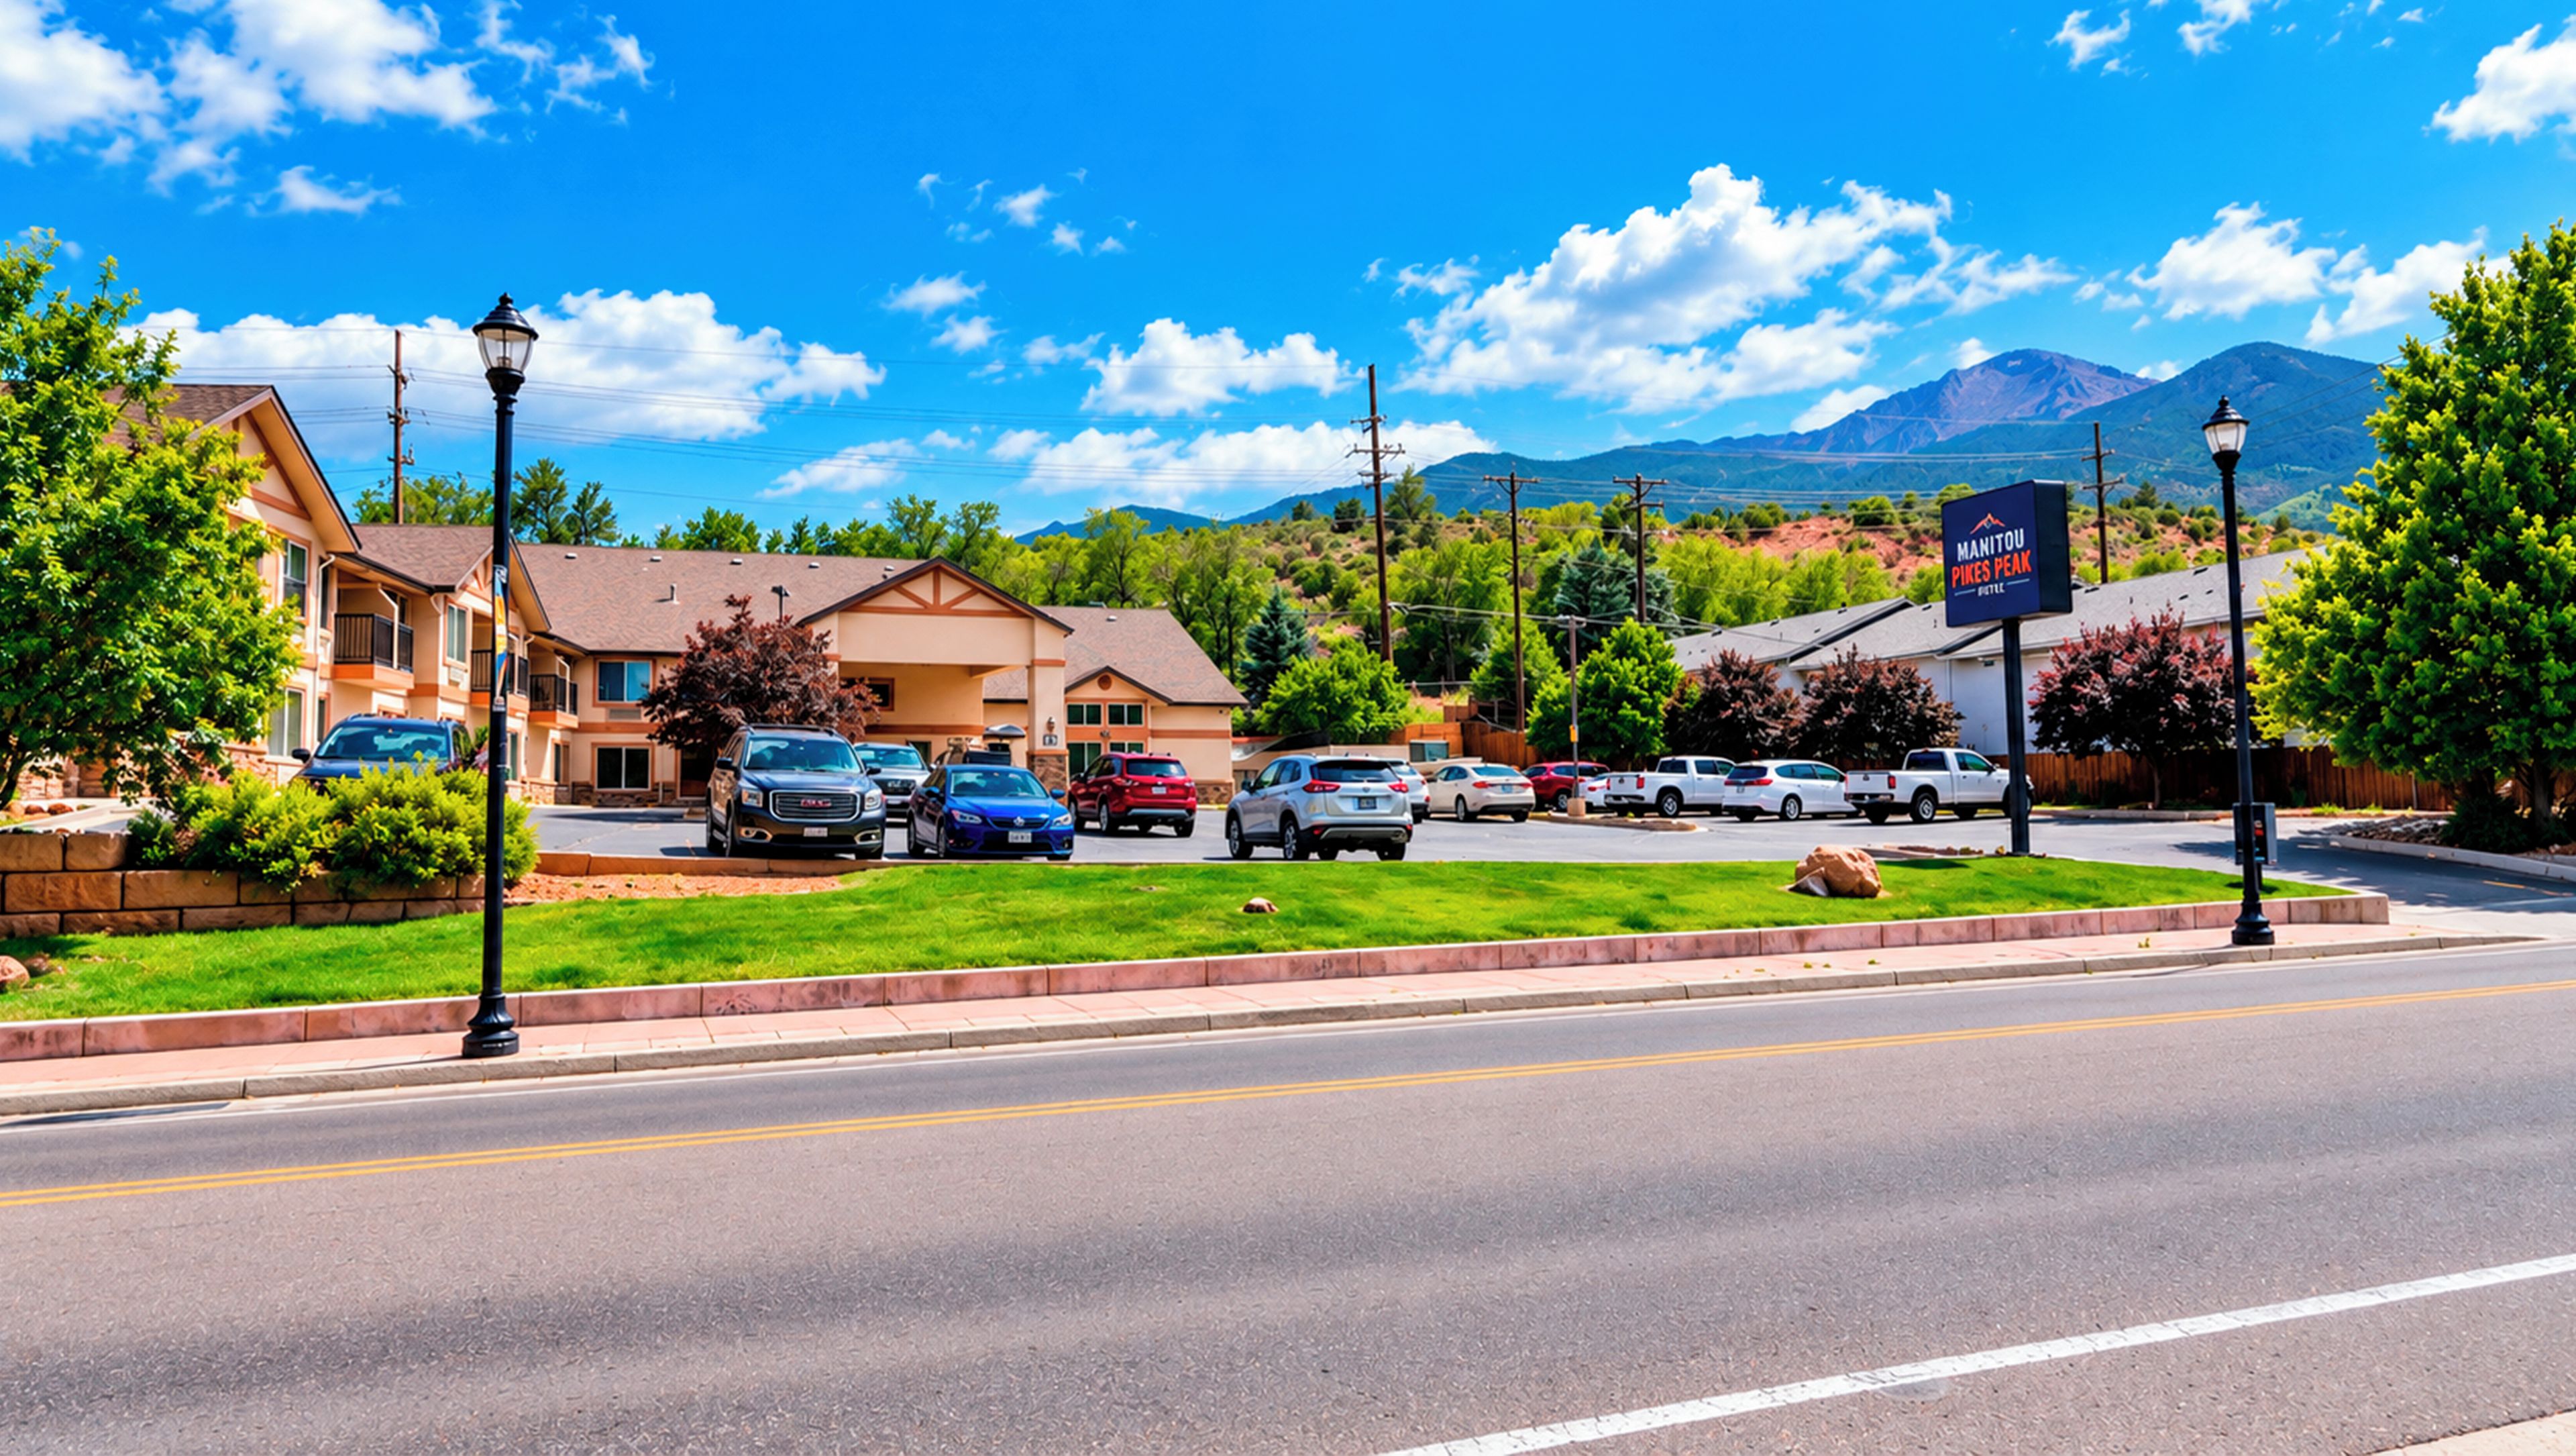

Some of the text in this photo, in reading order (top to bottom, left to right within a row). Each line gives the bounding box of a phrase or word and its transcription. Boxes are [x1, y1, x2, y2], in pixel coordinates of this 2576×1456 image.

[1957, 528, 2024, 562] MANITOU
[1951, 550, 2032, 588] PIKES PEAK
